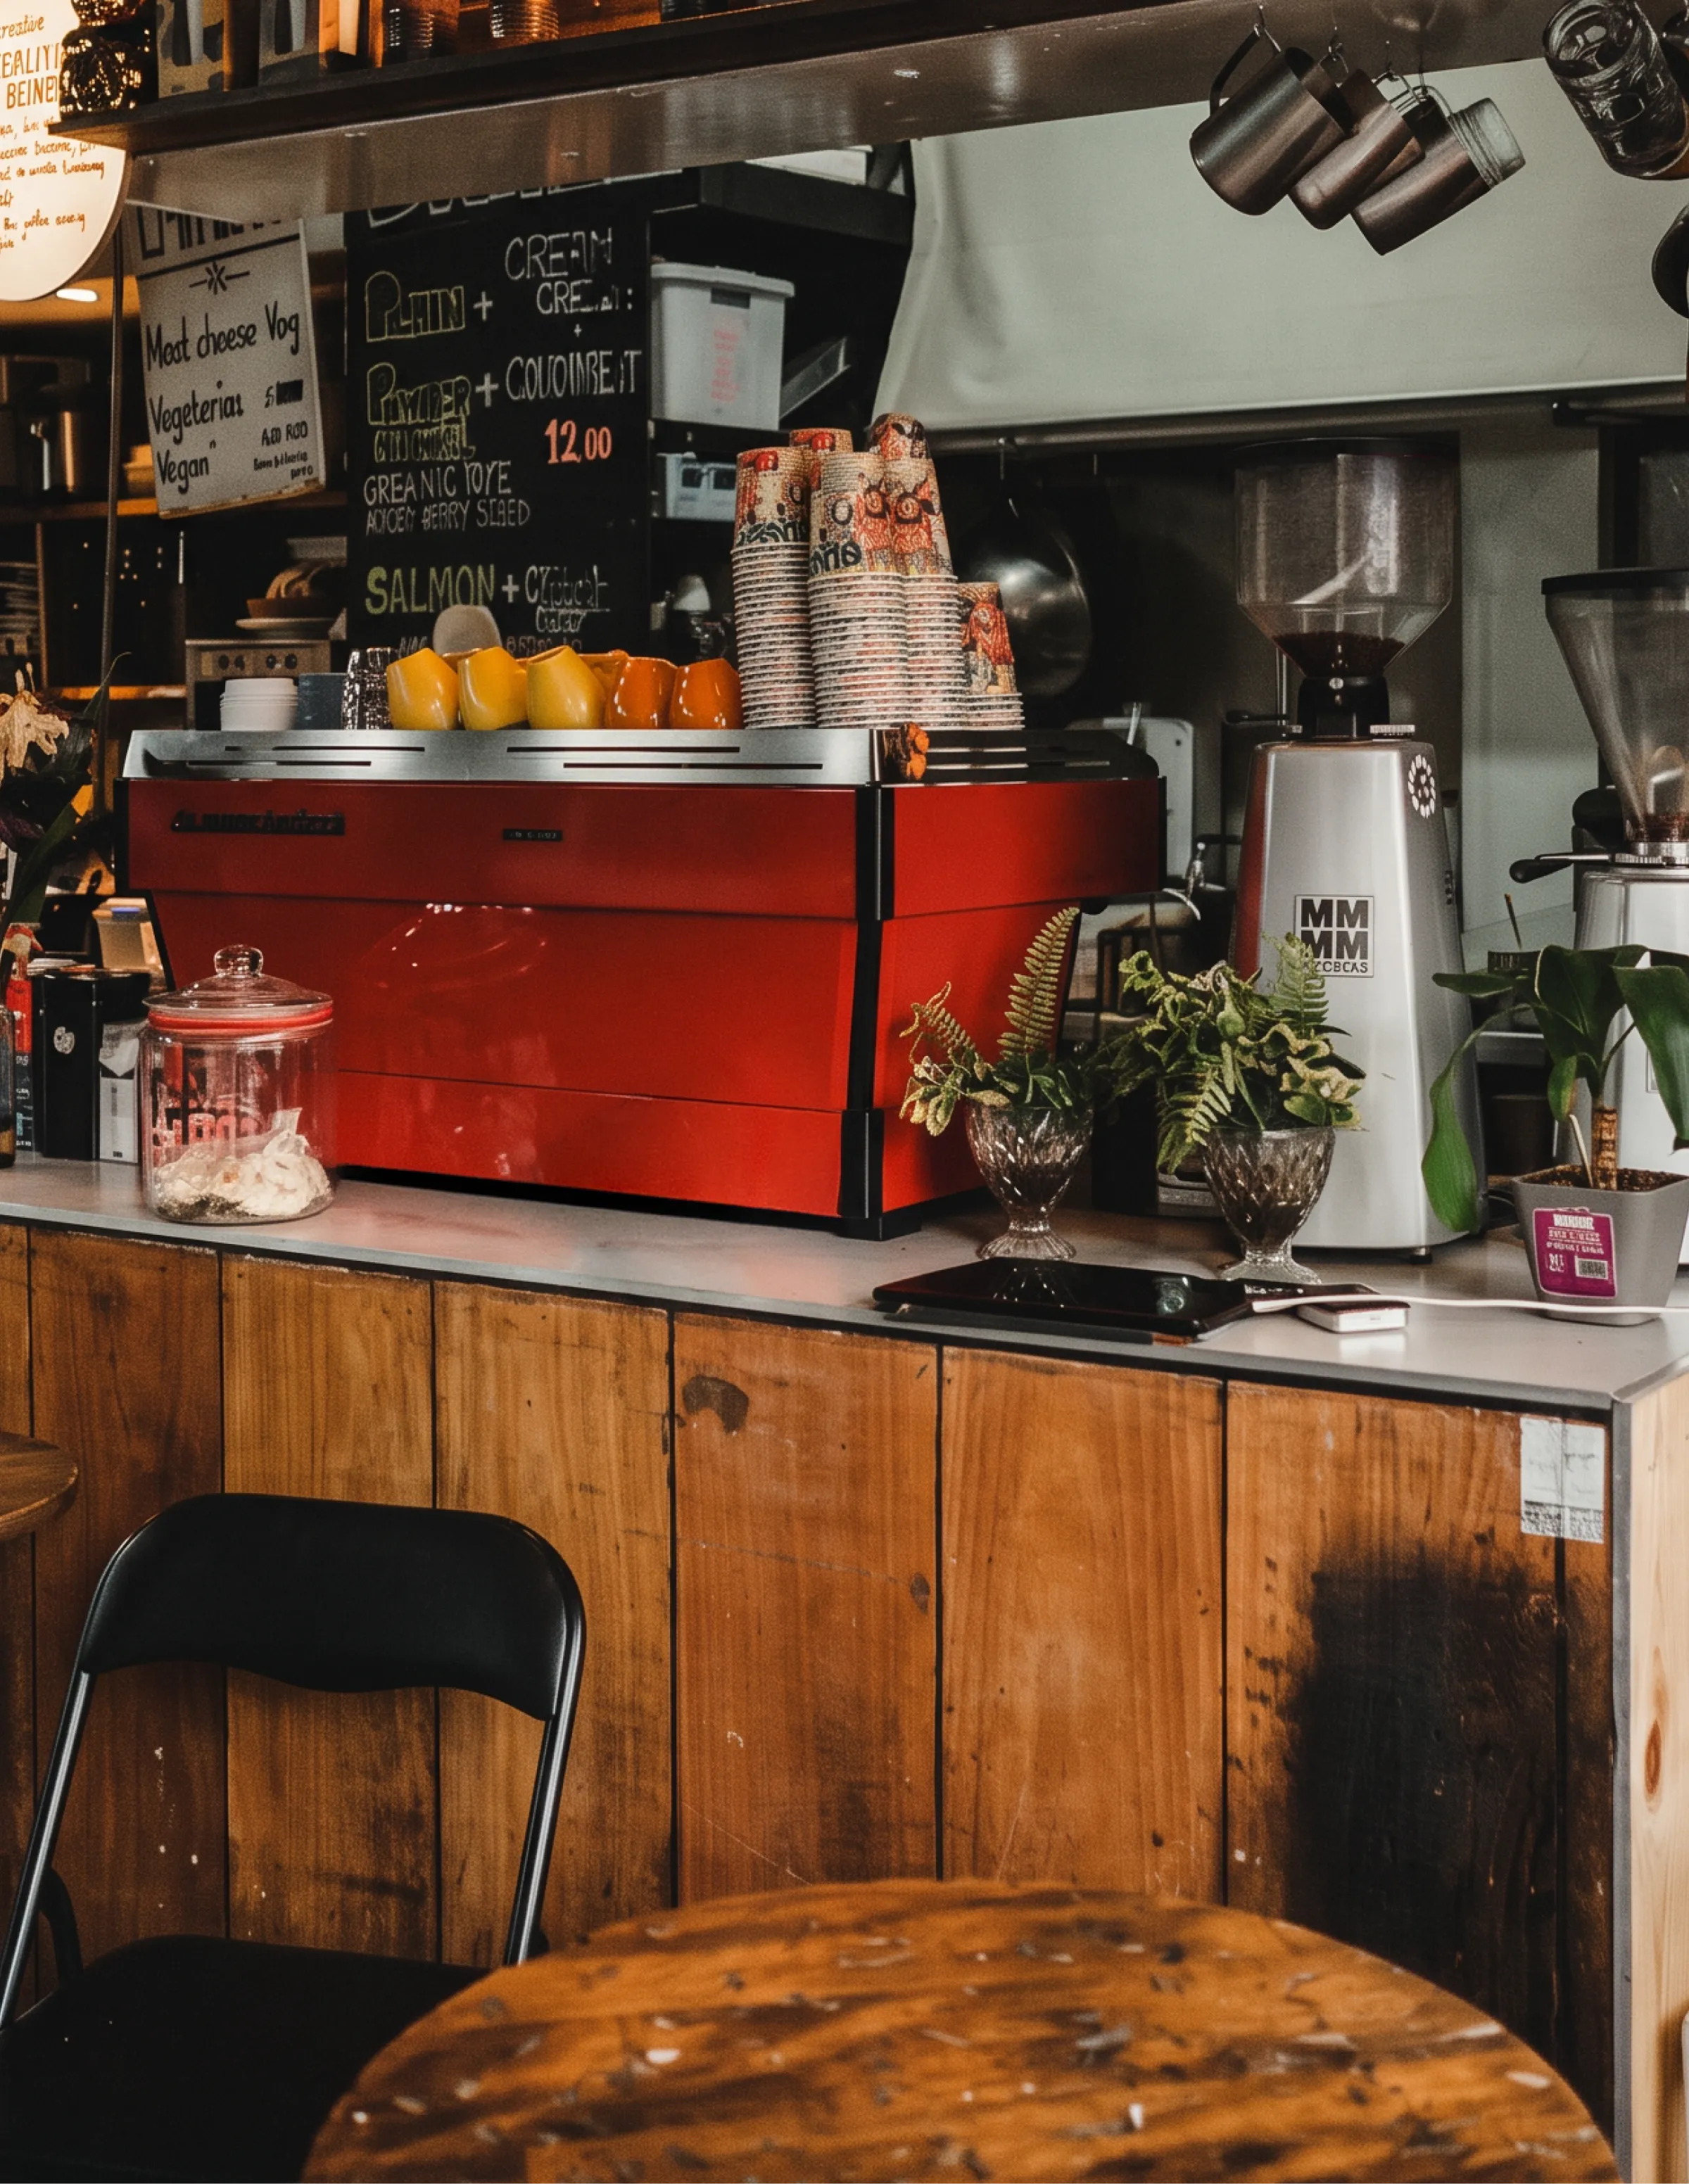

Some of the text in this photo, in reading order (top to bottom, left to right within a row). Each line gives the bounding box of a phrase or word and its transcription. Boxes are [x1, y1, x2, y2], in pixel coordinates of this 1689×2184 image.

[0, 15, 44, 39] reative
[197, 312, 257, 358] cheese
[157, 449, 209, 494] Vegan
[365, 564, 495, 615] SALMON
